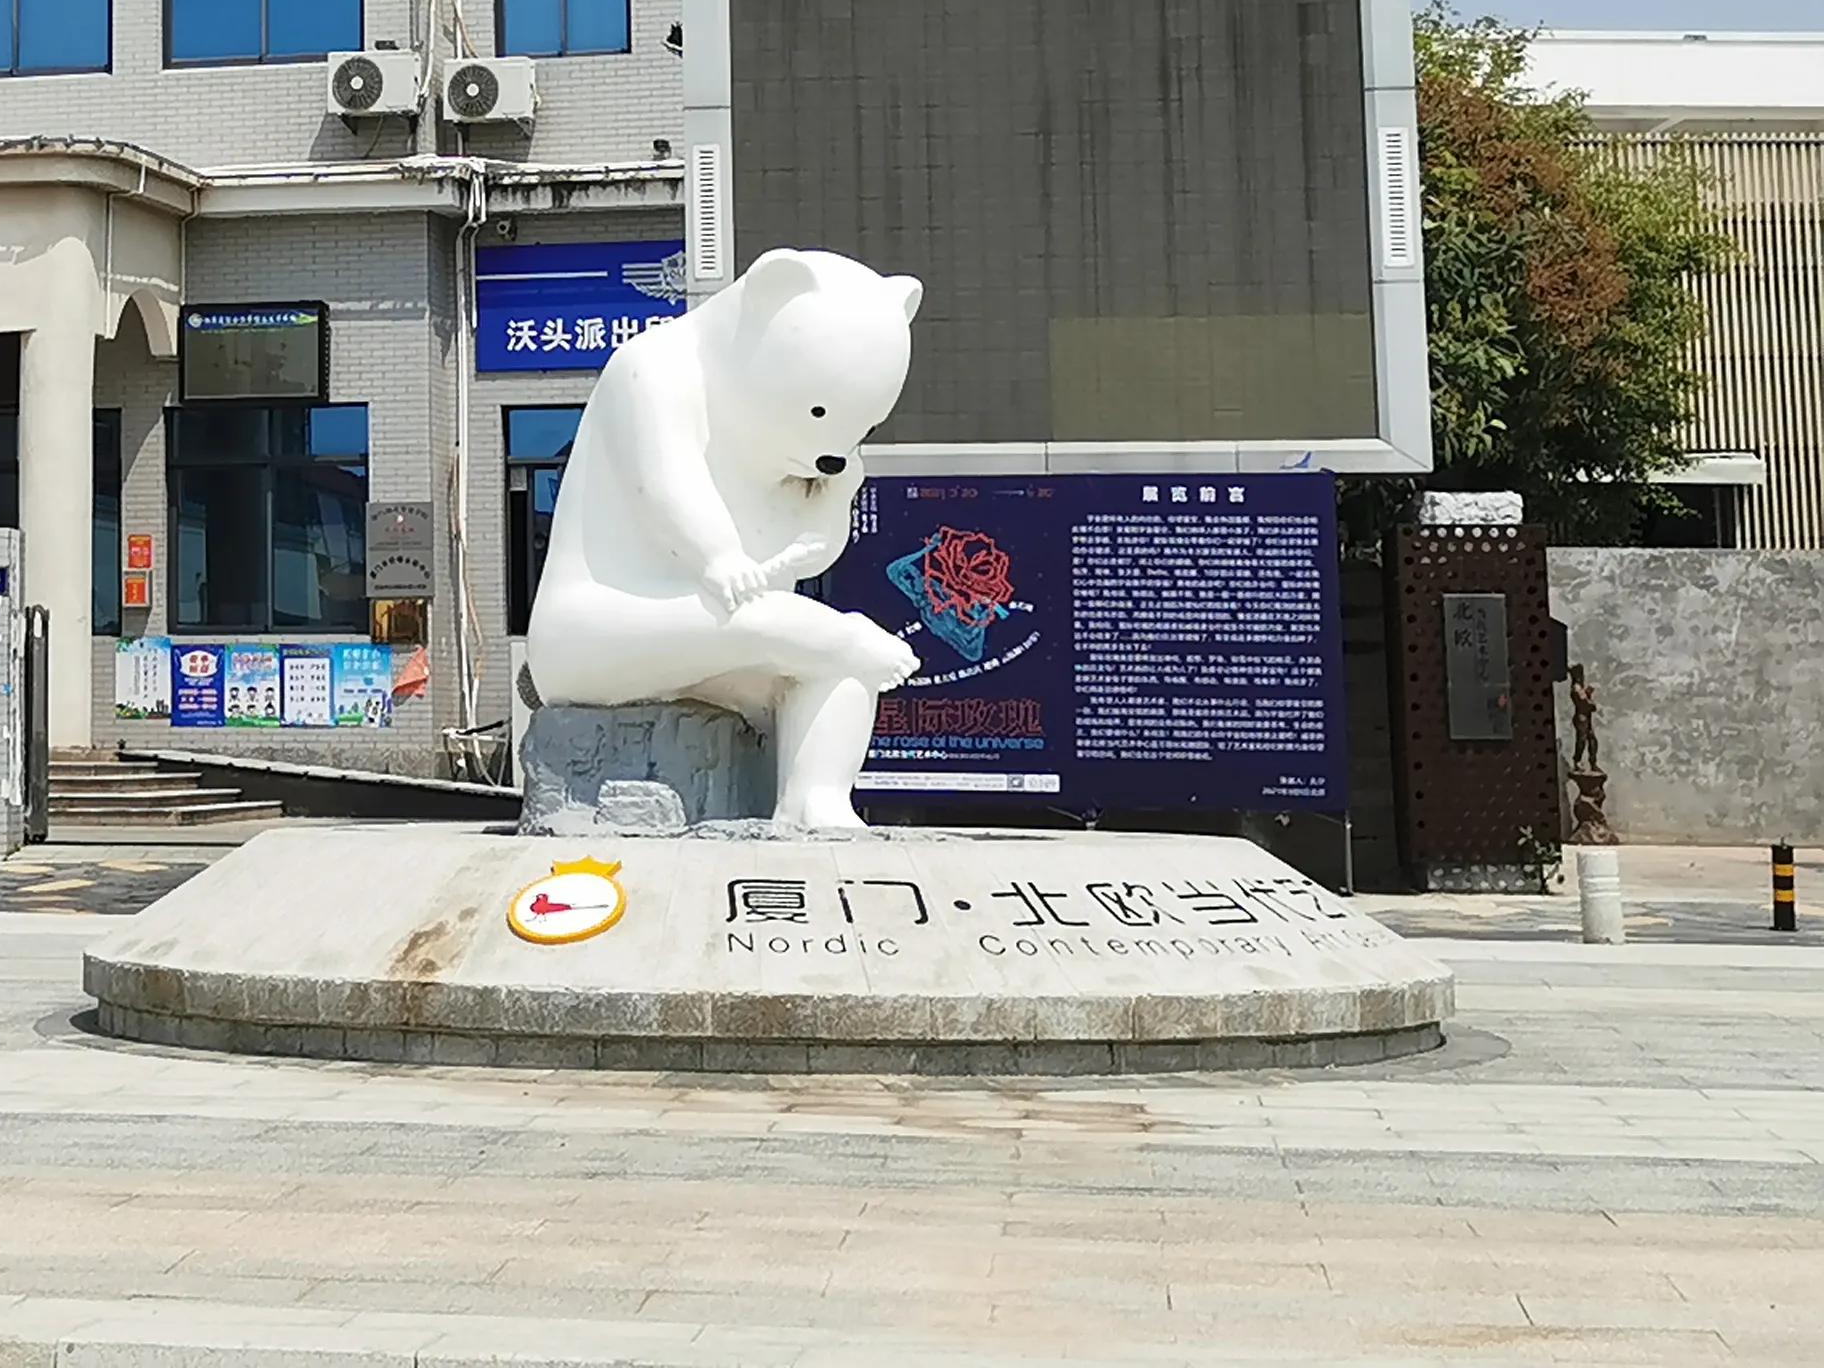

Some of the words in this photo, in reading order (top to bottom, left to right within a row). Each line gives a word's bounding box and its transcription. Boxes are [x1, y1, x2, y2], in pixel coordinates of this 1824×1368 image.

[506, 316, 677, 352] 沃头派出
[975, 736, 1045, 751] universe
[727, 932, 900, 955] Nordic
[979, 934, 1292, 959] Contemporary
